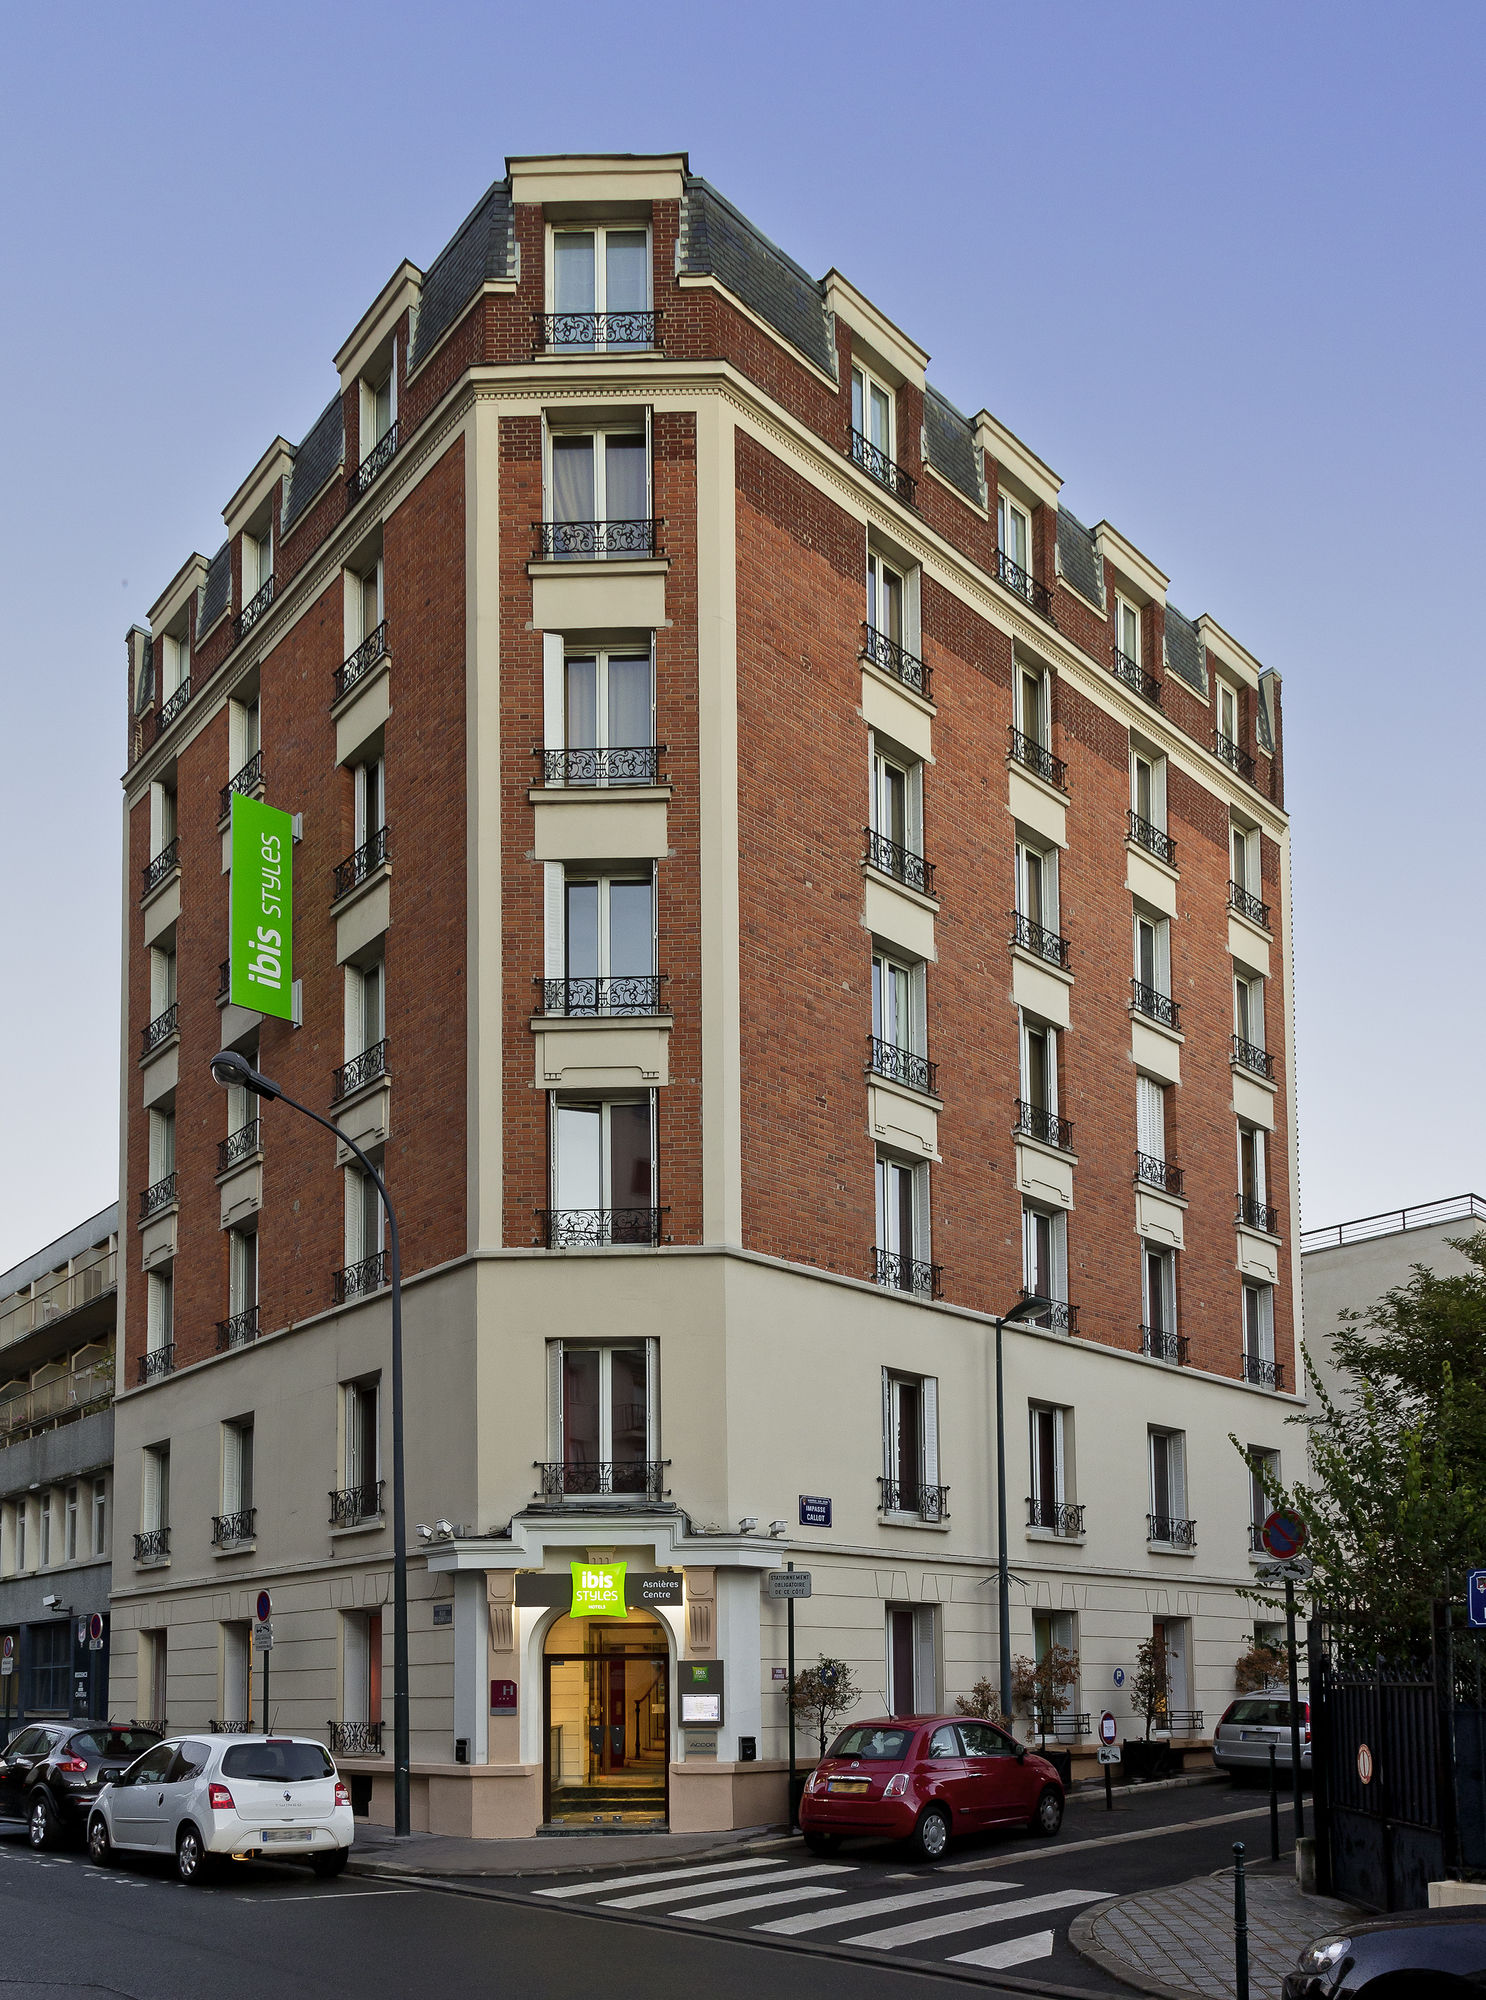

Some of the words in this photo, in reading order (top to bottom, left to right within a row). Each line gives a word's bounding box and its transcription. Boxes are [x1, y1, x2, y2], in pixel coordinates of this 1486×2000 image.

[248, 926, 282, 989] ibis
[805, 1505, 826, 1514] IMPASSE
[806, 1513, 825, 1522] CALLOT
[581, 1571, 613, 1589] ibis
[642, 1580, 679, 1588] Asnières
[642, 1590, 671, 1599] Centre
[503, 1685, 514, 1696] H
